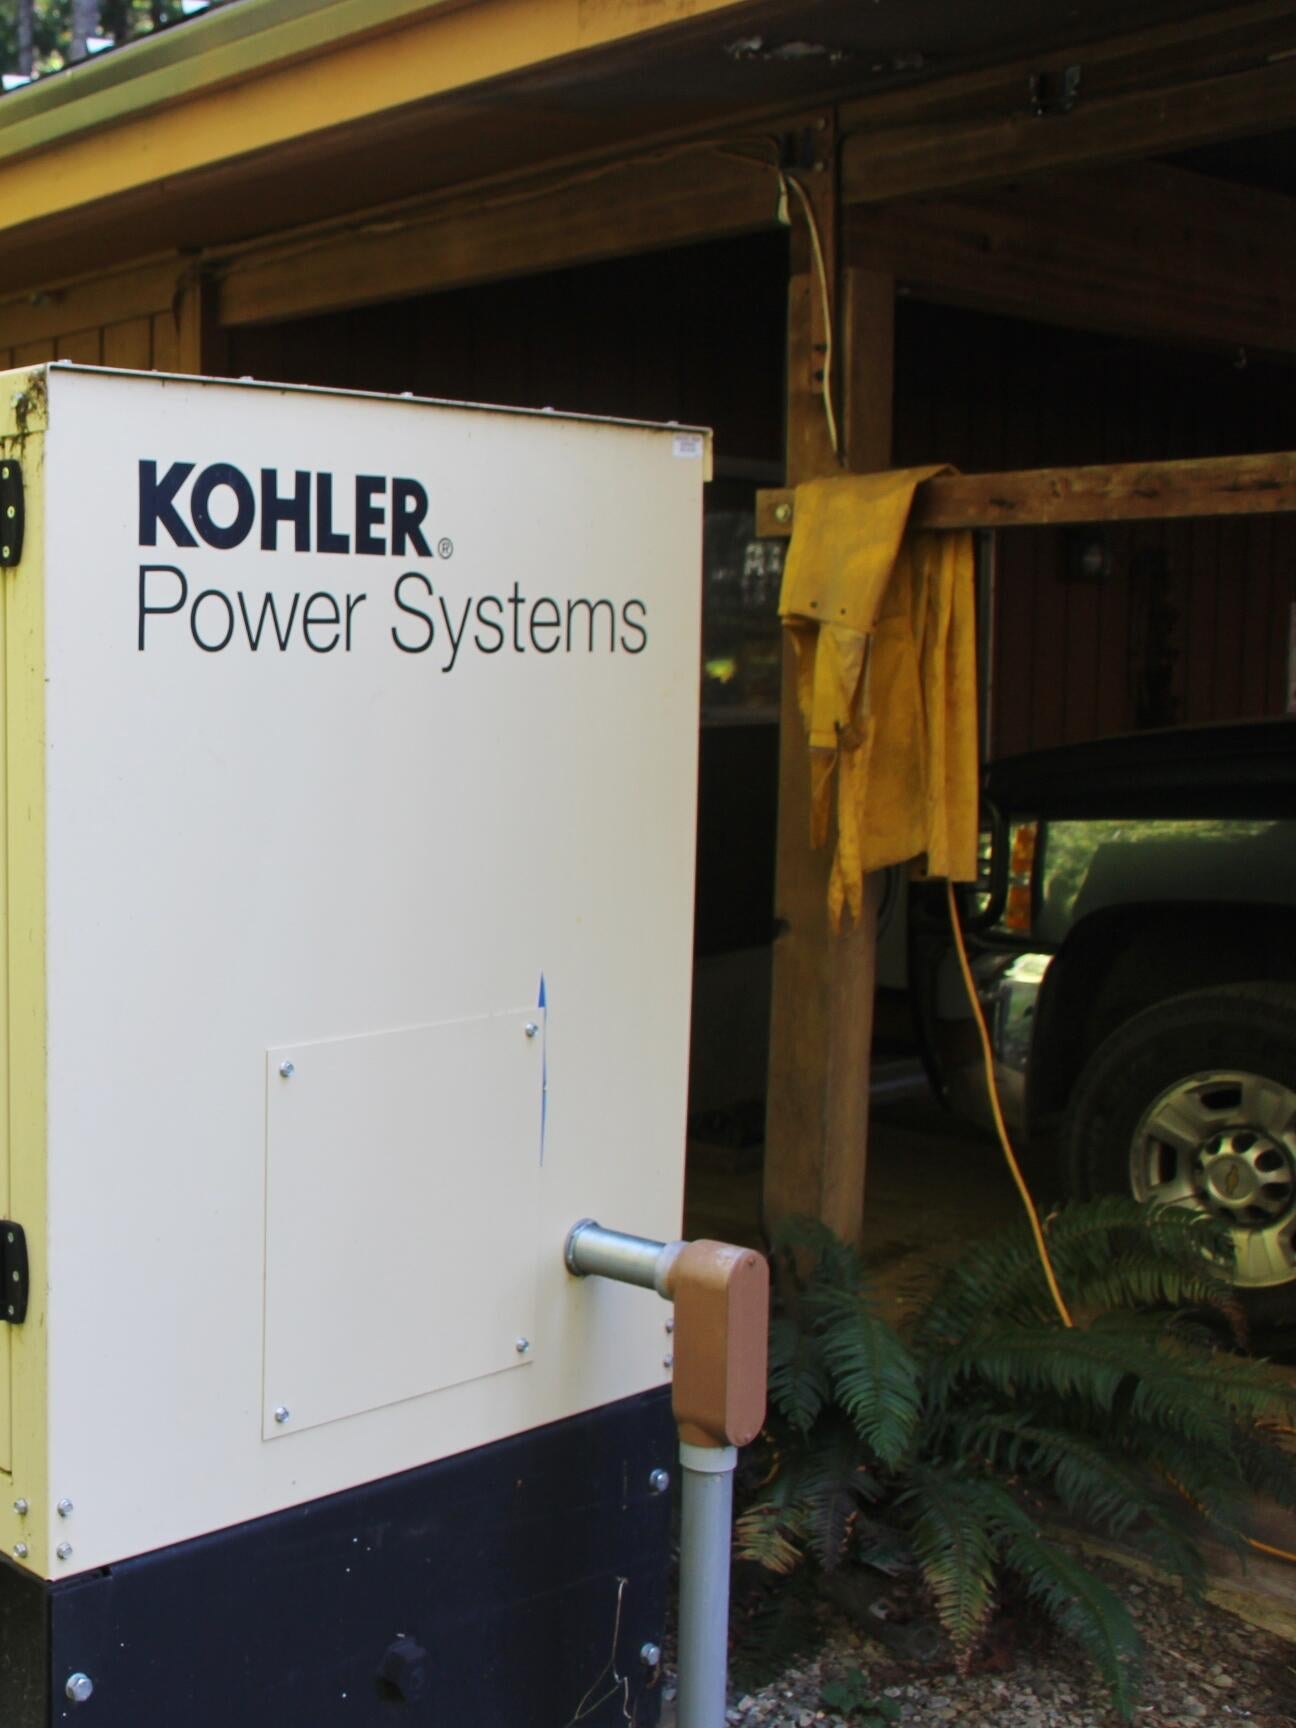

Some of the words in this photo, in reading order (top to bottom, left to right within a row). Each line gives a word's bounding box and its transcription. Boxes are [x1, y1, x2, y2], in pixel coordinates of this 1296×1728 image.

[138, 459, 433, 558] KOHLER
[137, 565, 367, 653] Power
[391, 572, 648, 673] Systems
